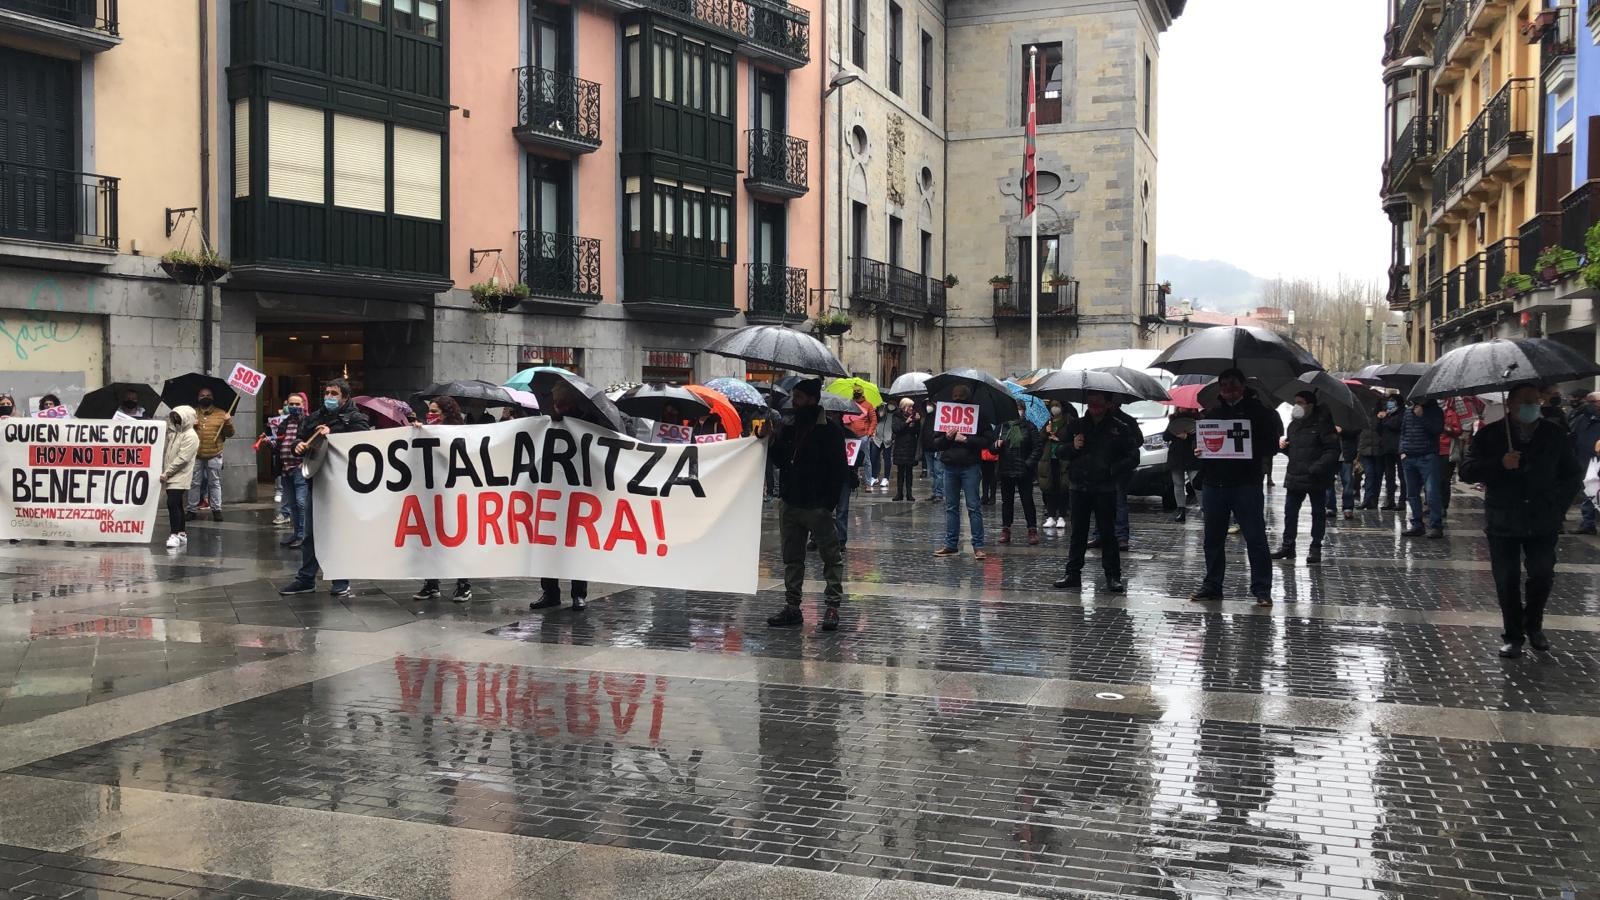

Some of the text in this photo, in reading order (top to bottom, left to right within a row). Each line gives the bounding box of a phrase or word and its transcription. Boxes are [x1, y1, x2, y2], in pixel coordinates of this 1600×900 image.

[235, 367, 261, 388] SOS
[940, 405, 975, 425] SOS
[5, 424, 158, 445] QUIEN TIENE OFICIO
[658, 424, 690, 440] SOS
[36, 447, 143, 465] HOY NO TIENE
[347, 427, 706, 498] OSTALARITZA
[12, 468, 149, 505] BENEFICIO
[100, 520, 145, 535] ORAIN!
[395, 489, 668, 556] AURRERA!
